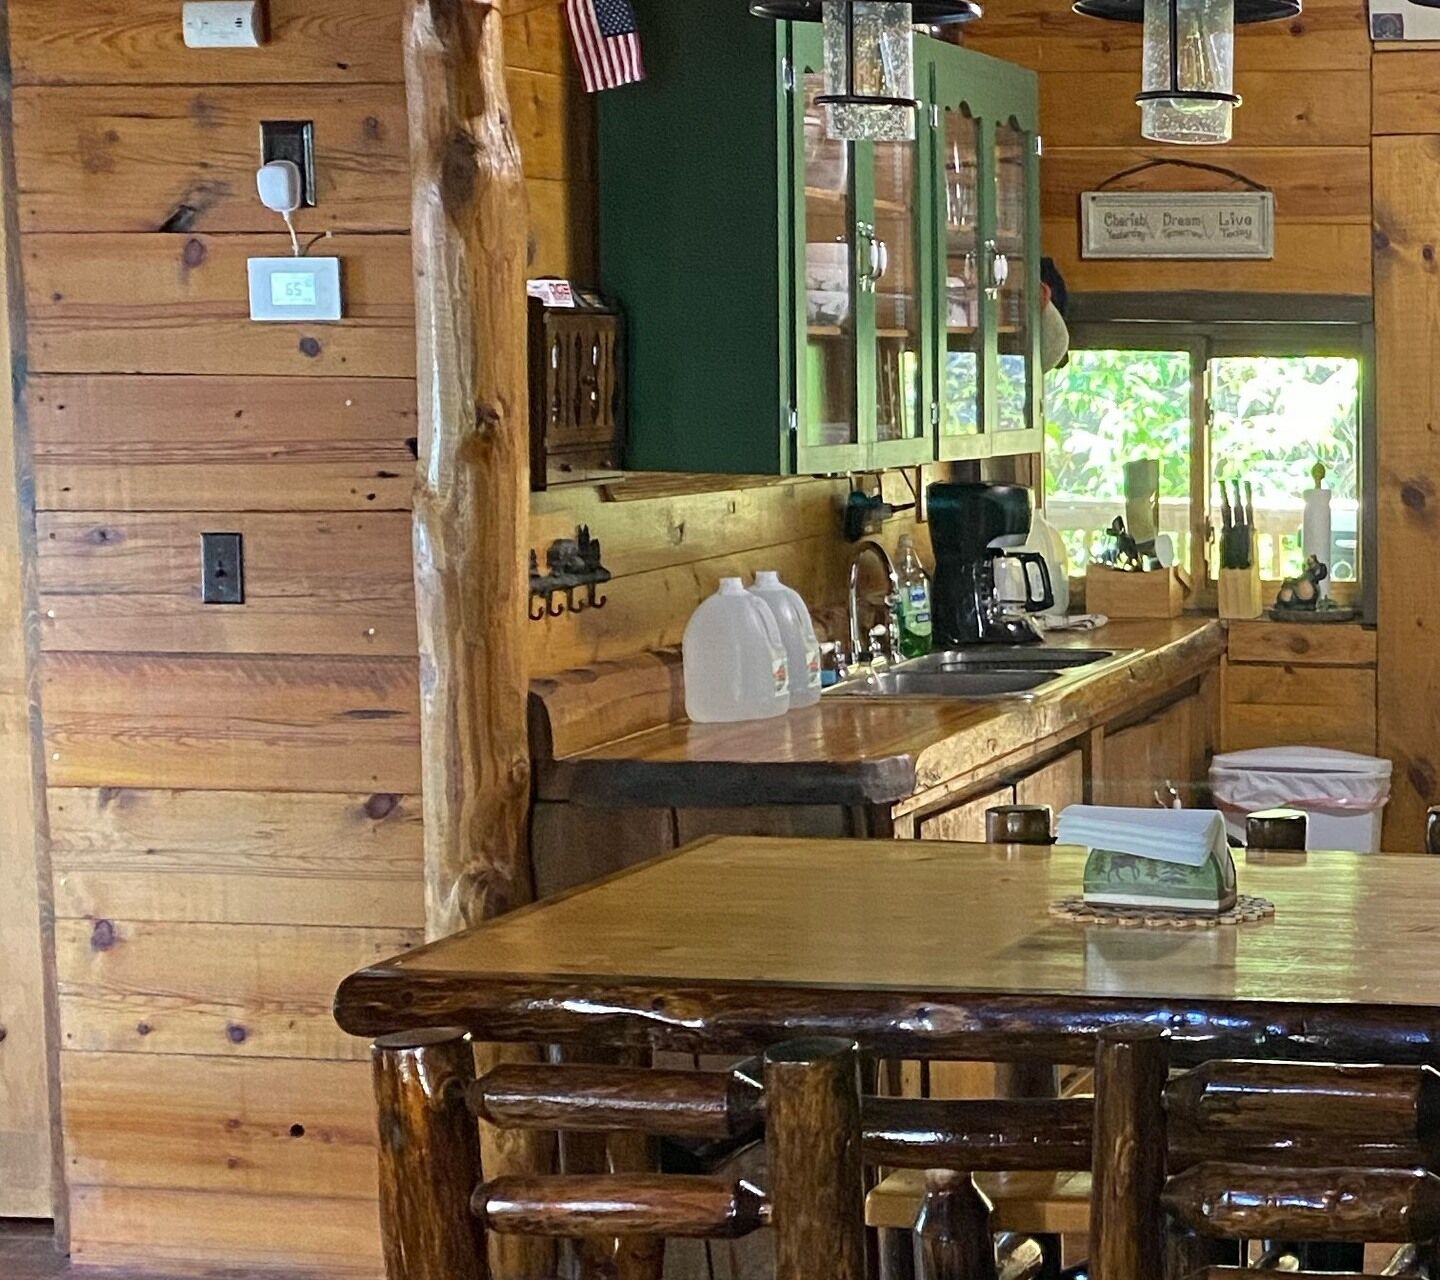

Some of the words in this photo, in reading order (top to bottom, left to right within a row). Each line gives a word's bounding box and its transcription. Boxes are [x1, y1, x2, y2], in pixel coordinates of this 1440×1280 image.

[1104, 211, 1146, 227] Cherish
[1162, 211, 1201, 226] Dream
[1218, 211, 1252, 227] Live
